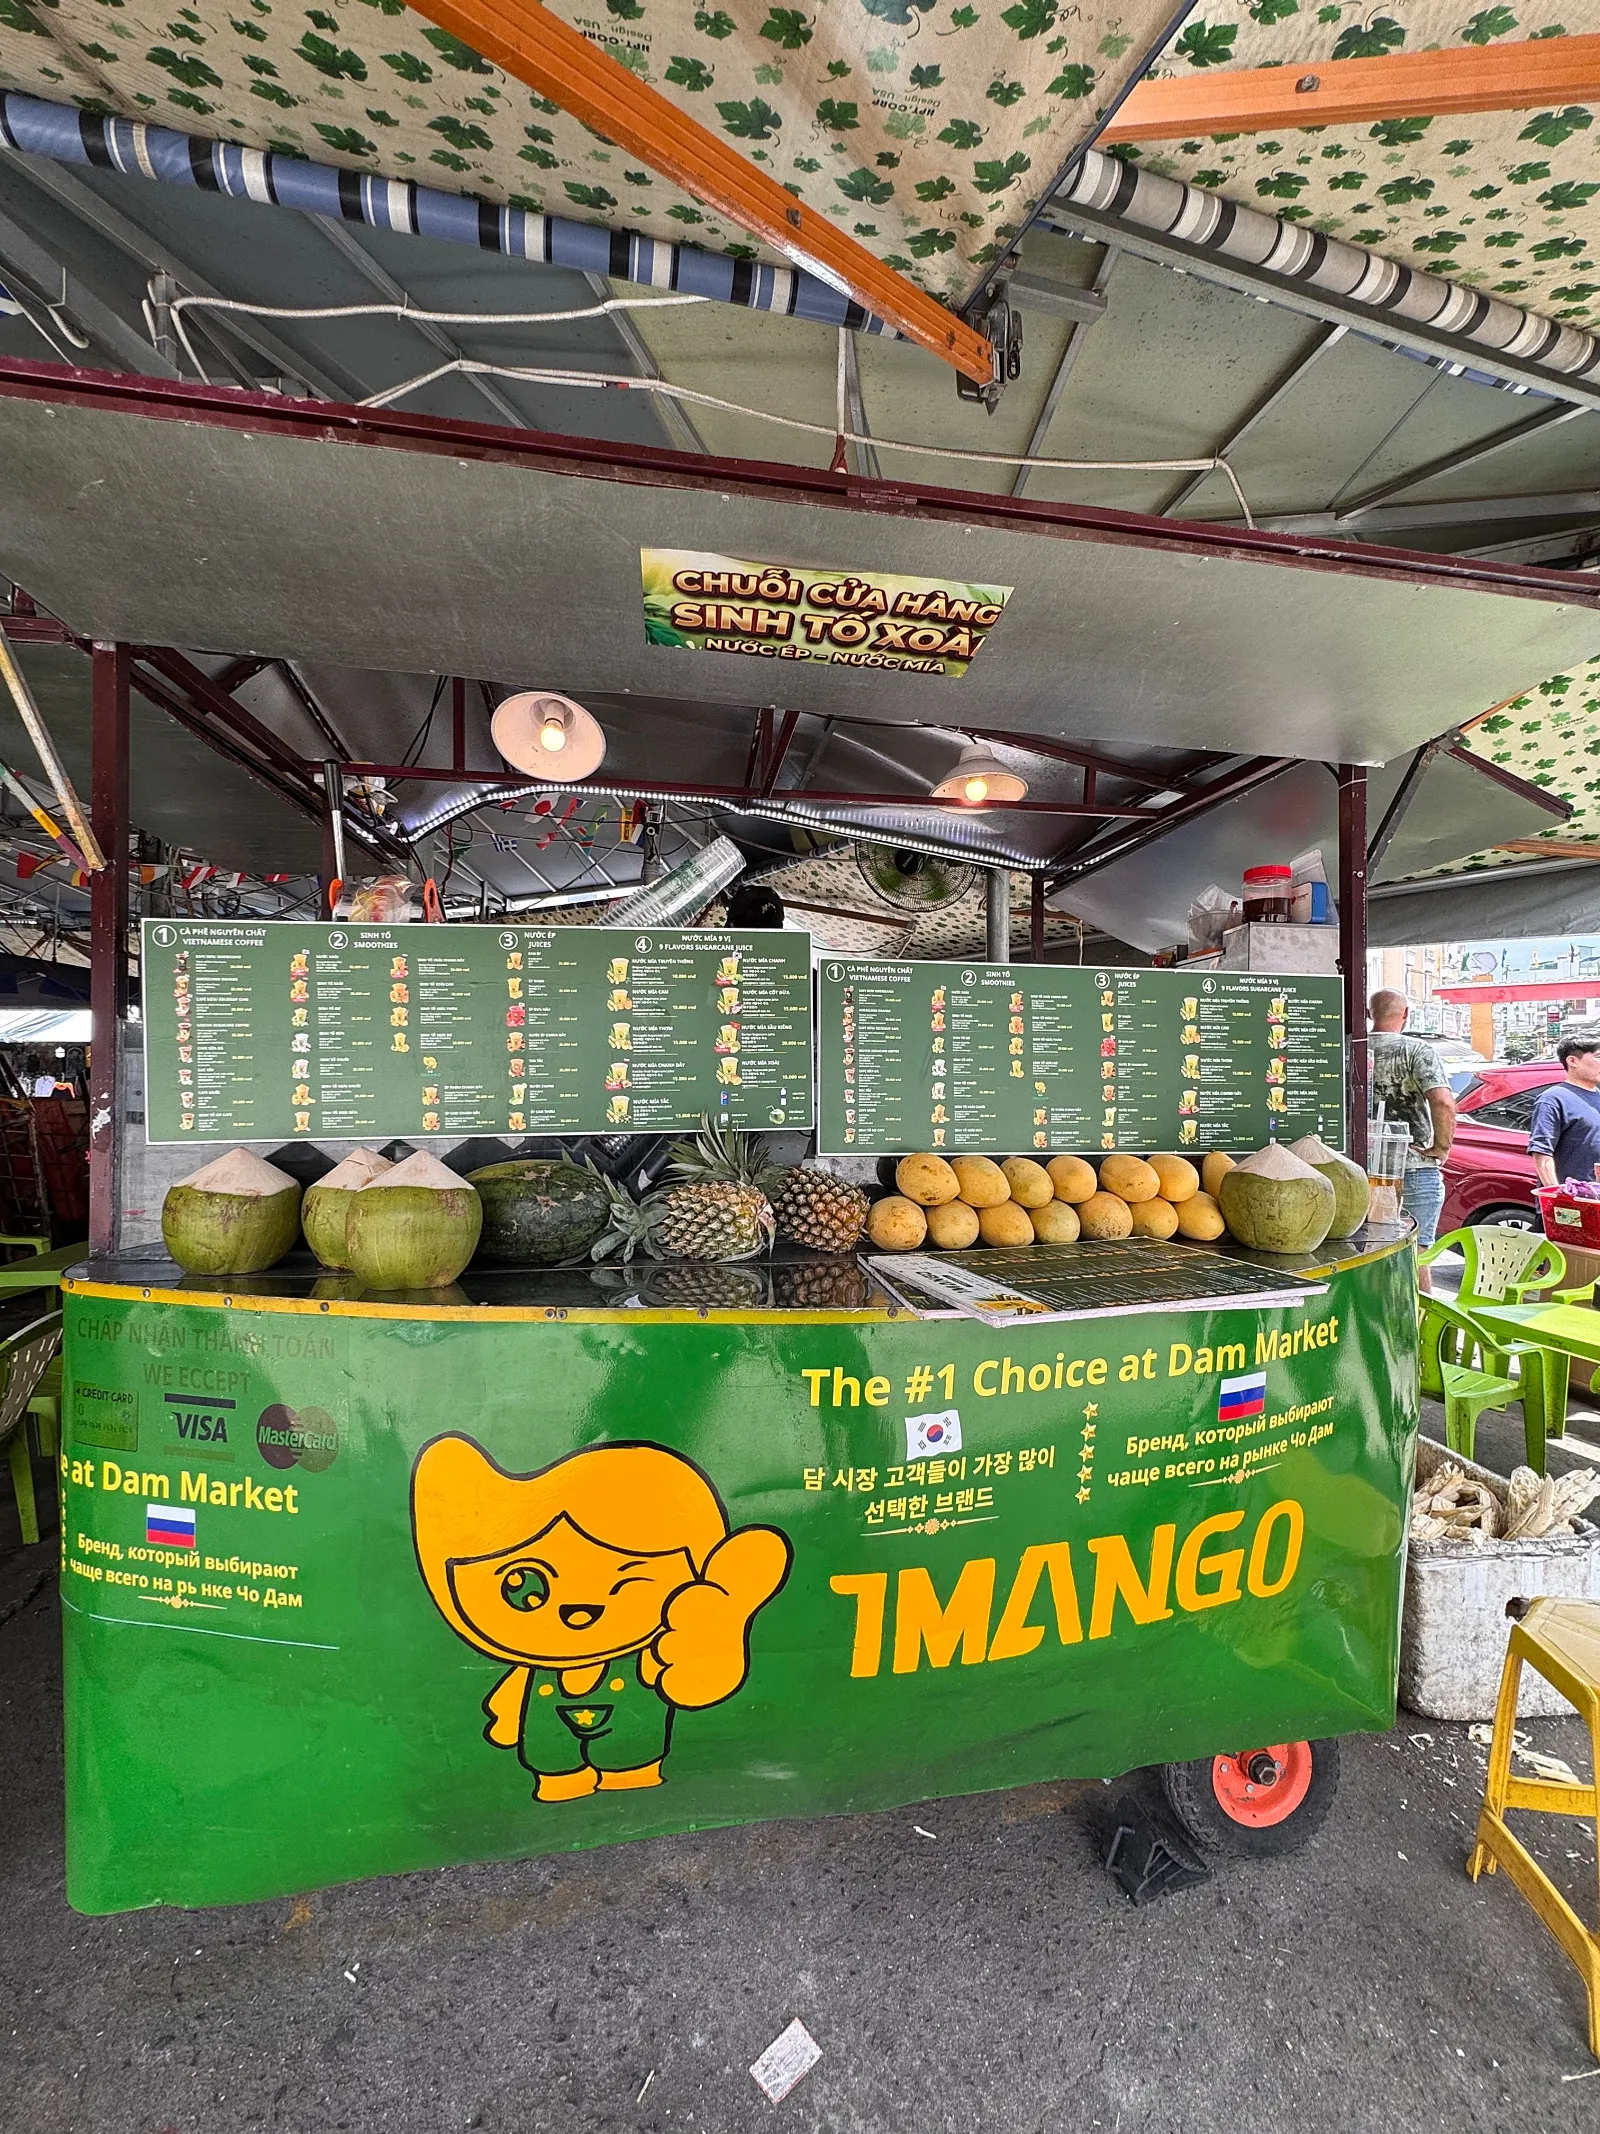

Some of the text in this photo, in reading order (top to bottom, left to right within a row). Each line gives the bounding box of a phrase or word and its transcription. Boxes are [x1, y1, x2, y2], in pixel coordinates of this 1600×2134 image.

[573, 16, 600, 30] USA
[872, 87, 894, 99] USA
[676, 569, 1002, 627] CHUỖI CỬA HÀNG
[673, 604, 791, 636] SINH
[803, 611, 870, 643] TỐ
[706, 638, 777, 658] NƯỚC
[780, 645, 811, 661] ÉP
[833, 652, 899, 669] NƯỚC
[903, 658, 945, 673] MÍA
[192, 927, 208, 936] PHÊ
[210, 928, 244, 936] NGUYÊN
[246, 928, 266, 937] CHẤT
[143, 1362, 250, 1394] WE ECCEPT
[801, 1315, 1339, 1407] The #1 Choice at Dam Market
[172, 1411, 228, 1443] VISA
[258, 1425, 337, 1450] MasterCard
[1126, 1396, 1334, 1458] Бренд, который выбирают
[803, 1445, 1055, 1492] 담 시장 고객들이 가장 많이
[1107, 1466, 1160, 1487] чаще
[1165, 1459, 1215, 1480] всего
[1219, 1453, 1239, 1470] на
[1242, 1440, 1287, 1468] рынке
[1308, 1421, 1333, 1448] Дам
[72, 1459, 94, 1488] at
[102, 1461, 170, 1499] Dam
[180, 1470, 299, 1514] Market
[864, 1486, 994, 1524] 선택한 브랜드
[78, 1533, 298, 1579] Бренд, который выбирают
[70, 1558, 102, 1582] чаще
[105, 1570, 148, 1588] всего
[153, 1576, 173, 1592] на
[263, 1590, 303, 1608] Дам
[829, 1499, 1305, 1678] 1MANGO
